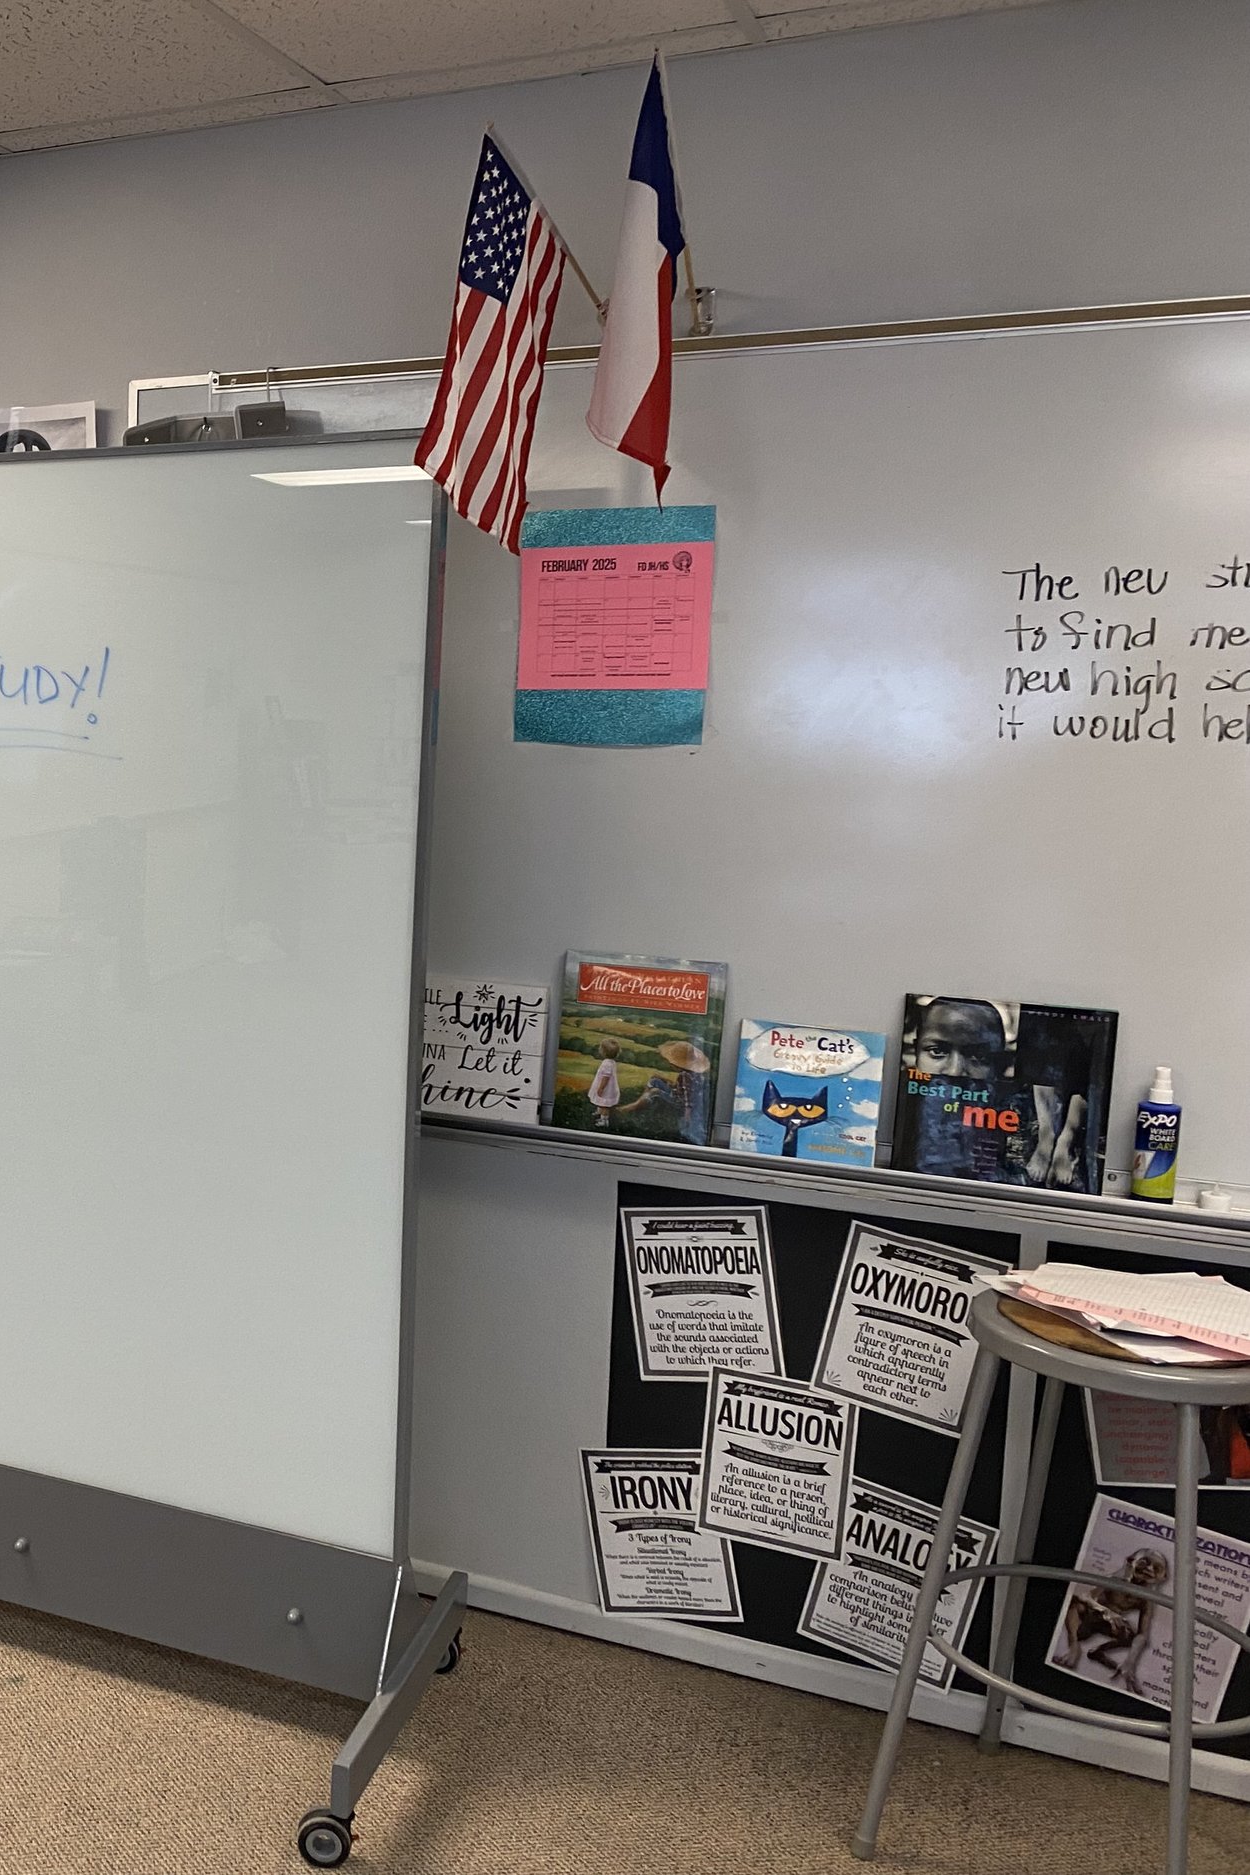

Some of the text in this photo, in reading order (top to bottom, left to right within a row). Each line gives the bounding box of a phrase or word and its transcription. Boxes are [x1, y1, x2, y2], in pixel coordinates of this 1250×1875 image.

[541, 558, 670, 572] FEBRUARY 2025 FD JH/HS
[1002, 562, 1079, 601] The
[1005, 614, 1047, 651] to
[1059, 611, 1157, 651] find
[1090, 660, 1177, 715] high
[998, 703, 1024, 740] it
[1052, 706, 1176, 744] would
[580, 975, 706, 1001] All the Places to Love
[440, 991, 543, 1045] Light
[770, 1030, 805, 1049] Pete
[817, 1037, 854, 1054] Cat's
[458, 1044, 523, 1076] Let it
[806, 1065, 827, 1074] Life
[908, 1068, 931, 1082] The
[422, 1064, 507, 1109] hine
[907, 1081, 989, 1103] Best Part
[943, 1102, 1020, 1133] of me
[1137, 1112, 1177, 1128] EXPO
[1148, 1142, 1178, 1151] CARE
[1149, 1134, 1175, 1142] BOARD
[637, 1246, 761, 1275] ONOMATOPOEIA
[850, 1263, 974, 1326] OXYMORO
[649, 1321, 764, 1333] use of words that imitate
[656, 1309, 753, 1321] Onomatopoeia is the
[650, 1343, 769, 1356] with the objects or actions
[657, 1333, 758, 1343] the sounds associated
[854, 1331, 949, 1369] figure of speech in
[858, 1322, 952, 1358] An oxymoron is a
[666, 1356, 755, 1368] to which they refer.
[847, 1354, 947, 1392] contradictory terms
[854, 1344, 945, 1382] which apparently
[857, 1369, 931, 1399] appear next to
[863, 1383, 919, 1407] each other.
[717, 1397, 843, 1451] ALLUSION
[609, 1476, 692, 1510] IRONY
[721, 1473, 826, 1505] reference to a person,
[724, 1463, 739, 1474] An
[742, 1467, 780, 1484] allusion
[783, 1474, 791, 1485] is
[803, 1478, 827, 1495] brief
[710, 1492, 834, 1529] literary, cultural, political
[718, 1484, 829, 1519] place, idea, or thing of
[711, 1505, 832, 1540] or historical significance.
[628, 1534, 692, 1546] 3 Types of Irony
[846, 1513, 972, 1575] ANALOY
[1204, 1559, 1238, 1576] means
[829, 1573, 888, 1602] comparison
[852, 1570, 869, 1583] An
[871, 1578, 914, 1603] analogy
[1214, 1575, 1250, 1593] writers
[1222, 1589, 1243, 1602] and
[827, 1593, 885, 1624] to highlight
[829, 1584, 903, 1618] different things
[849, 1615, 861, 1627] of
[1196, 1664, 1220, 1677] their
